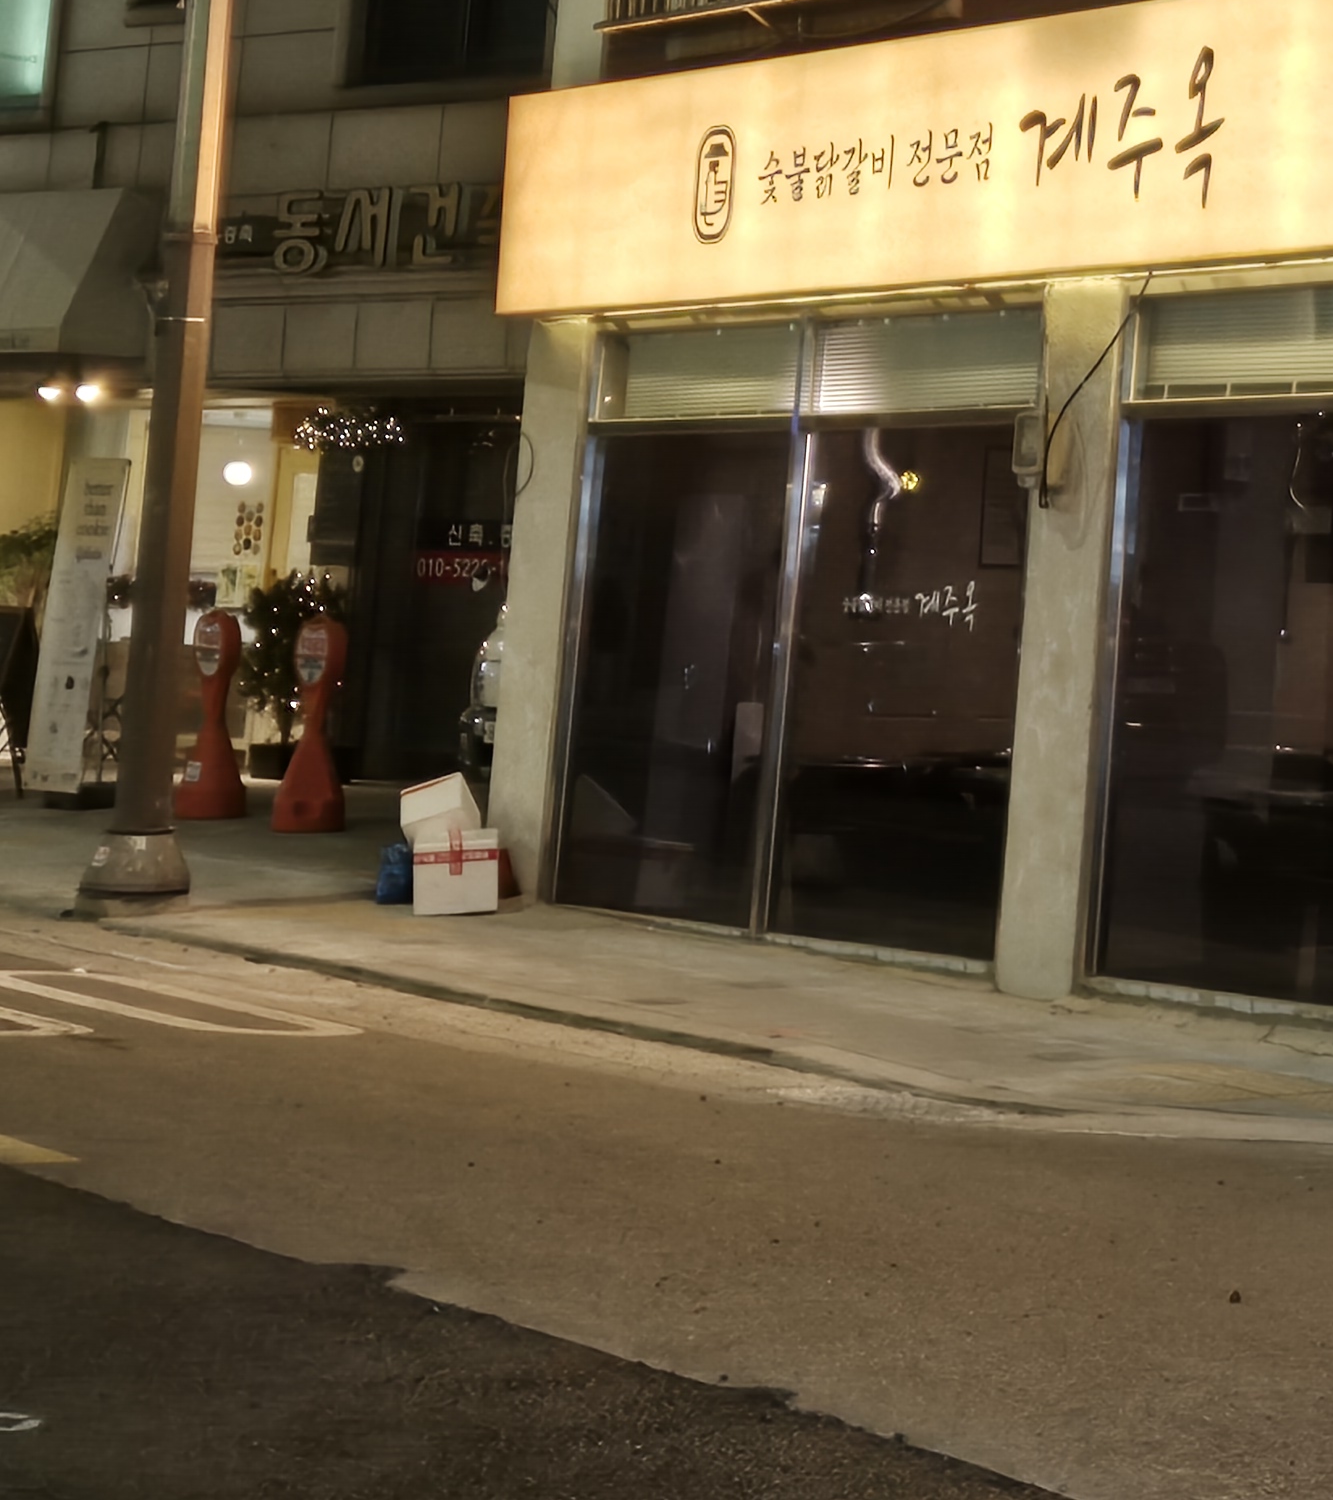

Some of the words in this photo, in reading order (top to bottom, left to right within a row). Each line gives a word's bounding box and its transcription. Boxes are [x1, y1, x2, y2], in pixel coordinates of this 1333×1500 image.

[757, 134, 895, 205] 숯불닭갈비
[906, 122, 994, 188] 전문점
[1019, 45, 1226, 209] 계주옥
